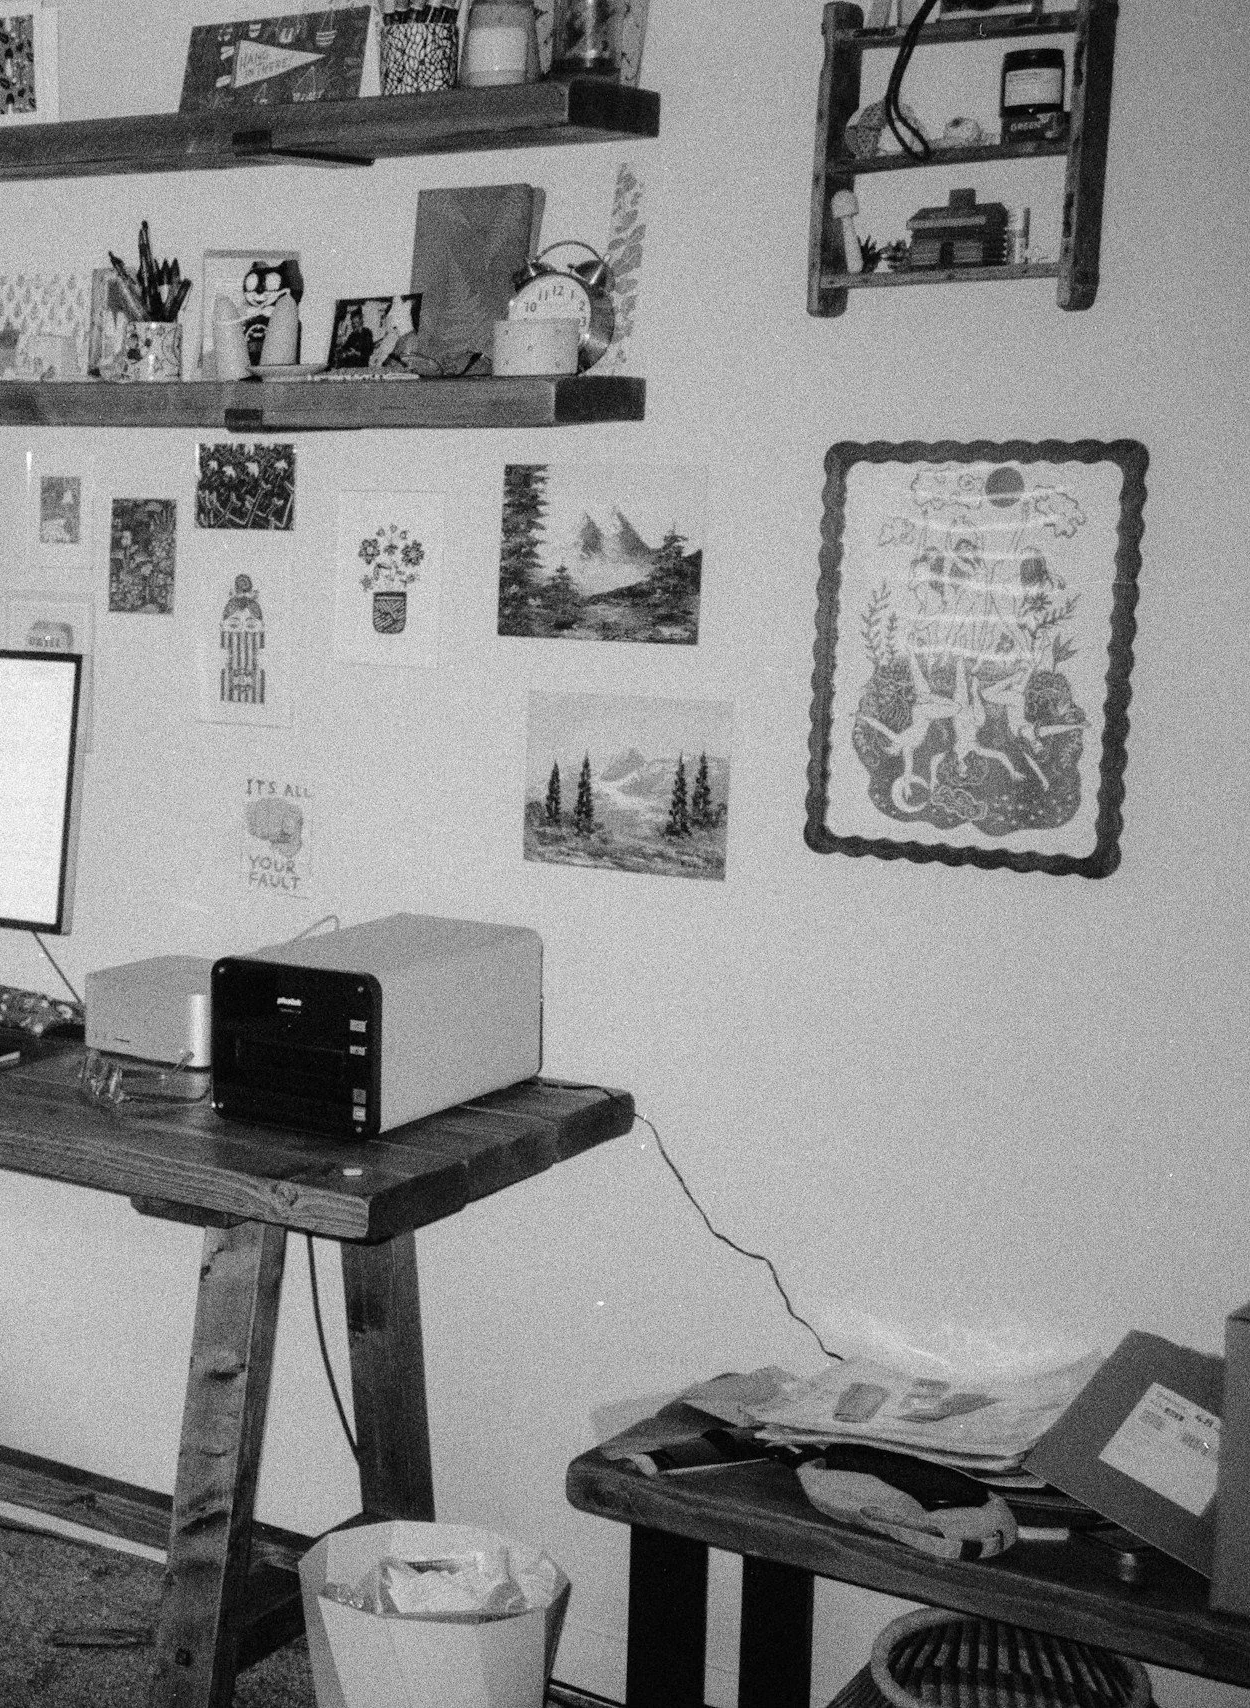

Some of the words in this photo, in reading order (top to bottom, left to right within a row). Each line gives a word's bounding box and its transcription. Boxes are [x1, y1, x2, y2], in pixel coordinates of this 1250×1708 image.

[553, 285, 564, 297] 12
[524, 301, 537, 313] 10
[579, 300, 586, 312] 2
[284, 783, 315, 799] ALL
[249, 853, 297, 874] YOUR
[248, 871, 301, 891] FAULT
